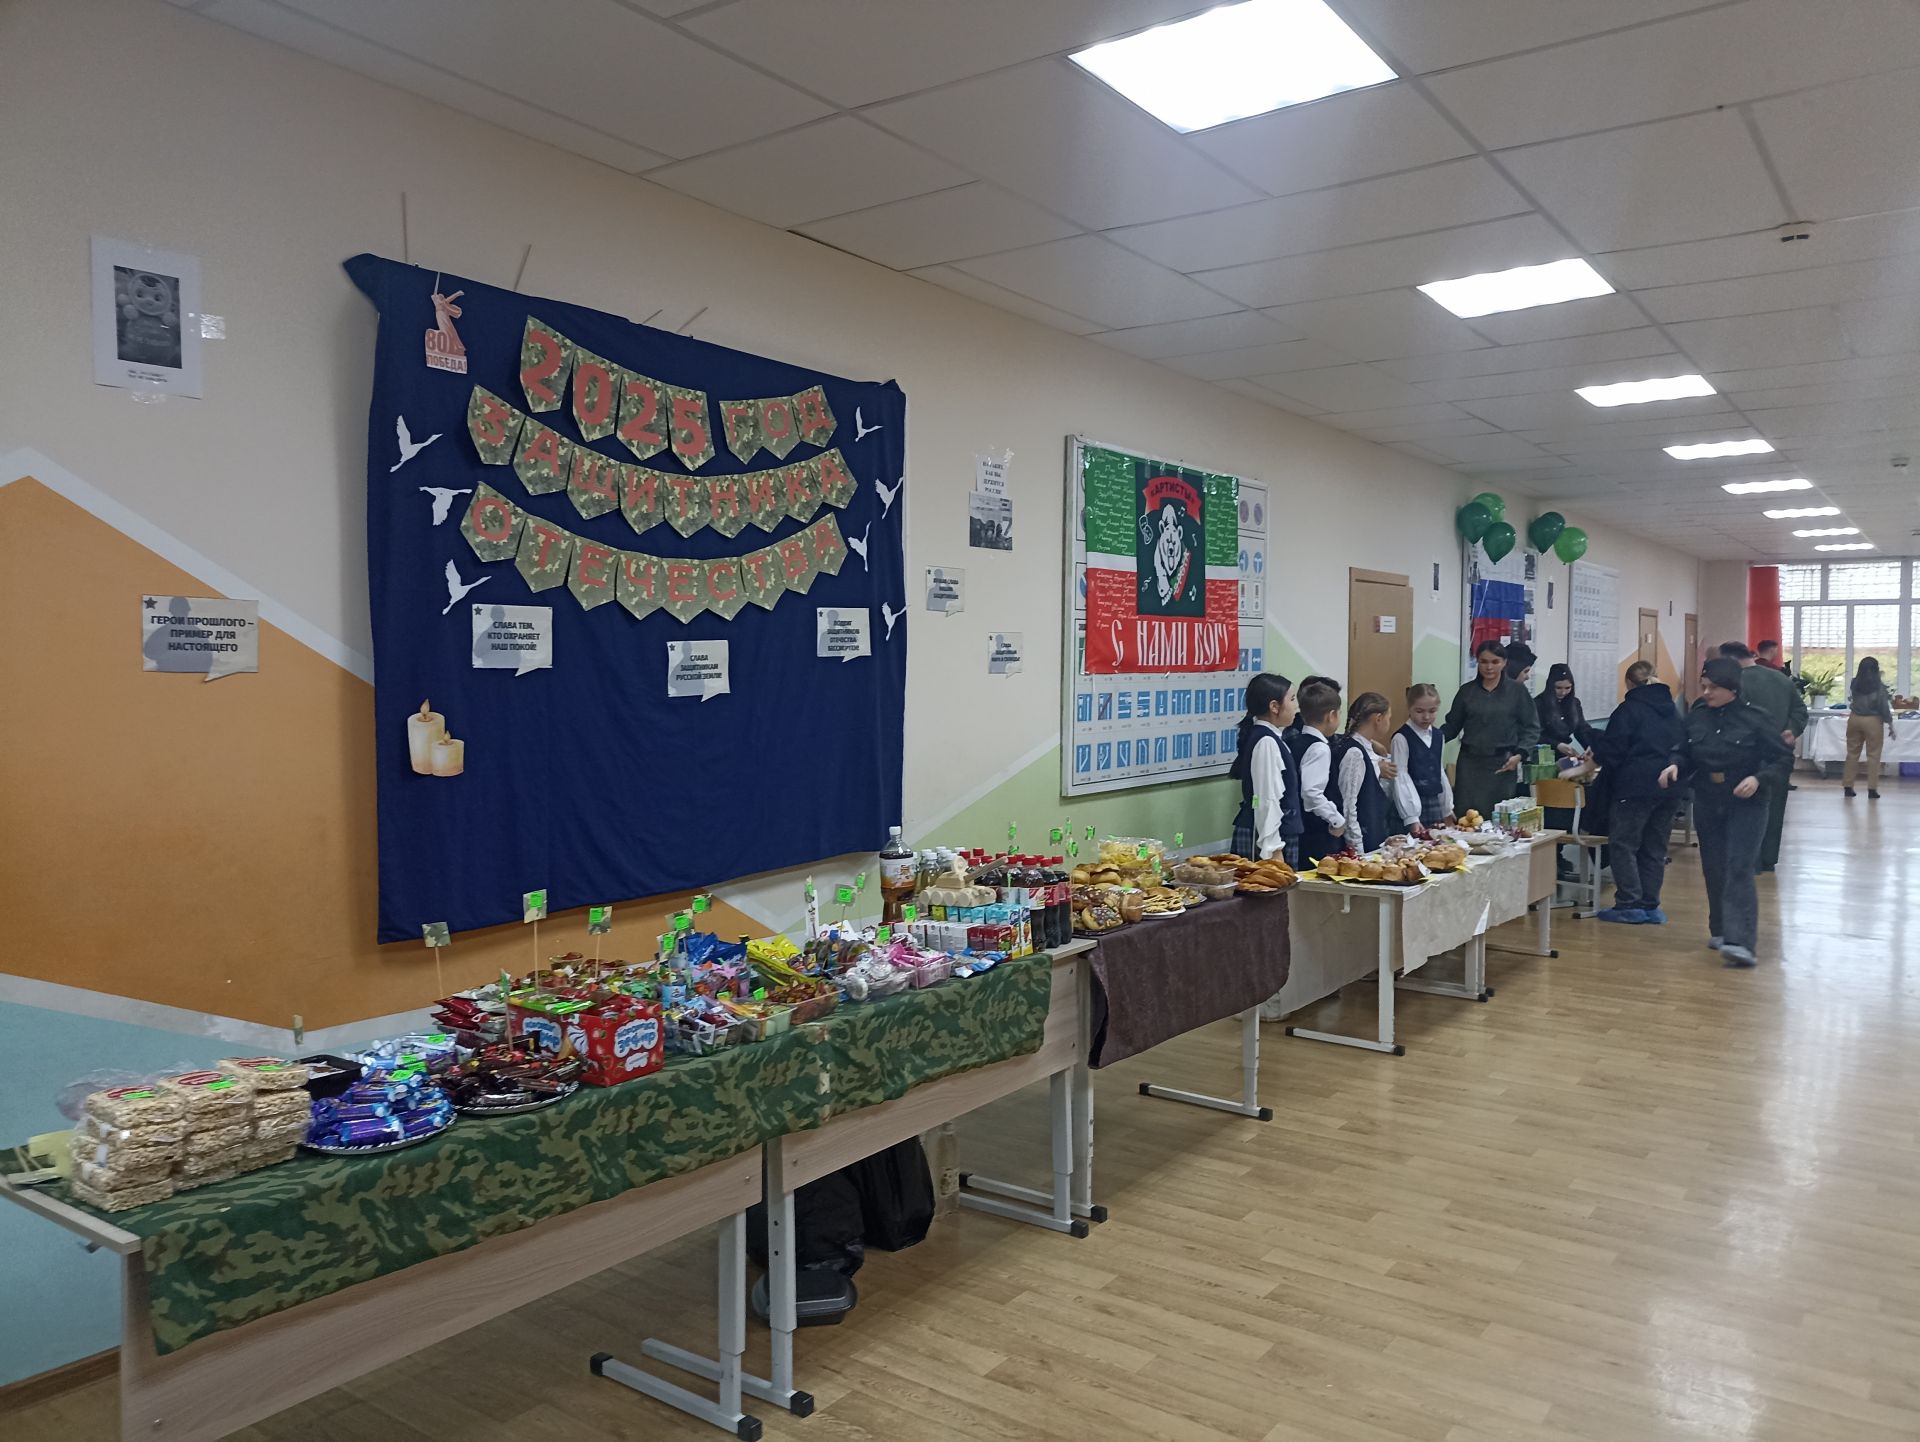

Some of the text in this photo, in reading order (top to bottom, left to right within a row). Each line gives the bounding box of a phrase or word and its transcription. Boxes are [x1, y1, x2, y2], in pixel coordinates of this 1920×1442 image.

[426, 330, 448, 353] 80
[521, 330, 833, 456] 2025 ГОД
[473, 395, 850, 519] ЗАЩИТНИКА
[472, 496, 842, 601] ОТЕЧЕСТВА
[151, 616, 185, 625] ГЕРОИ
[187, 617, 246, 627] ПРОШЛОГО
[493, 621, 517, 629] СЛАВА
[170, 629, 236, 640] ПРИМЕР ДЛЯ
[487, 632, 502, 640] КТО
[168, 642, 238, 653] НАСТОЯЩЕГО
[491, 643, 508, 651] НАШ
[1111, 619, 1124, 667] С
[1137, 620, 1188, 666] НАМИ
[690, 654, 709, 662] СЛАВА
